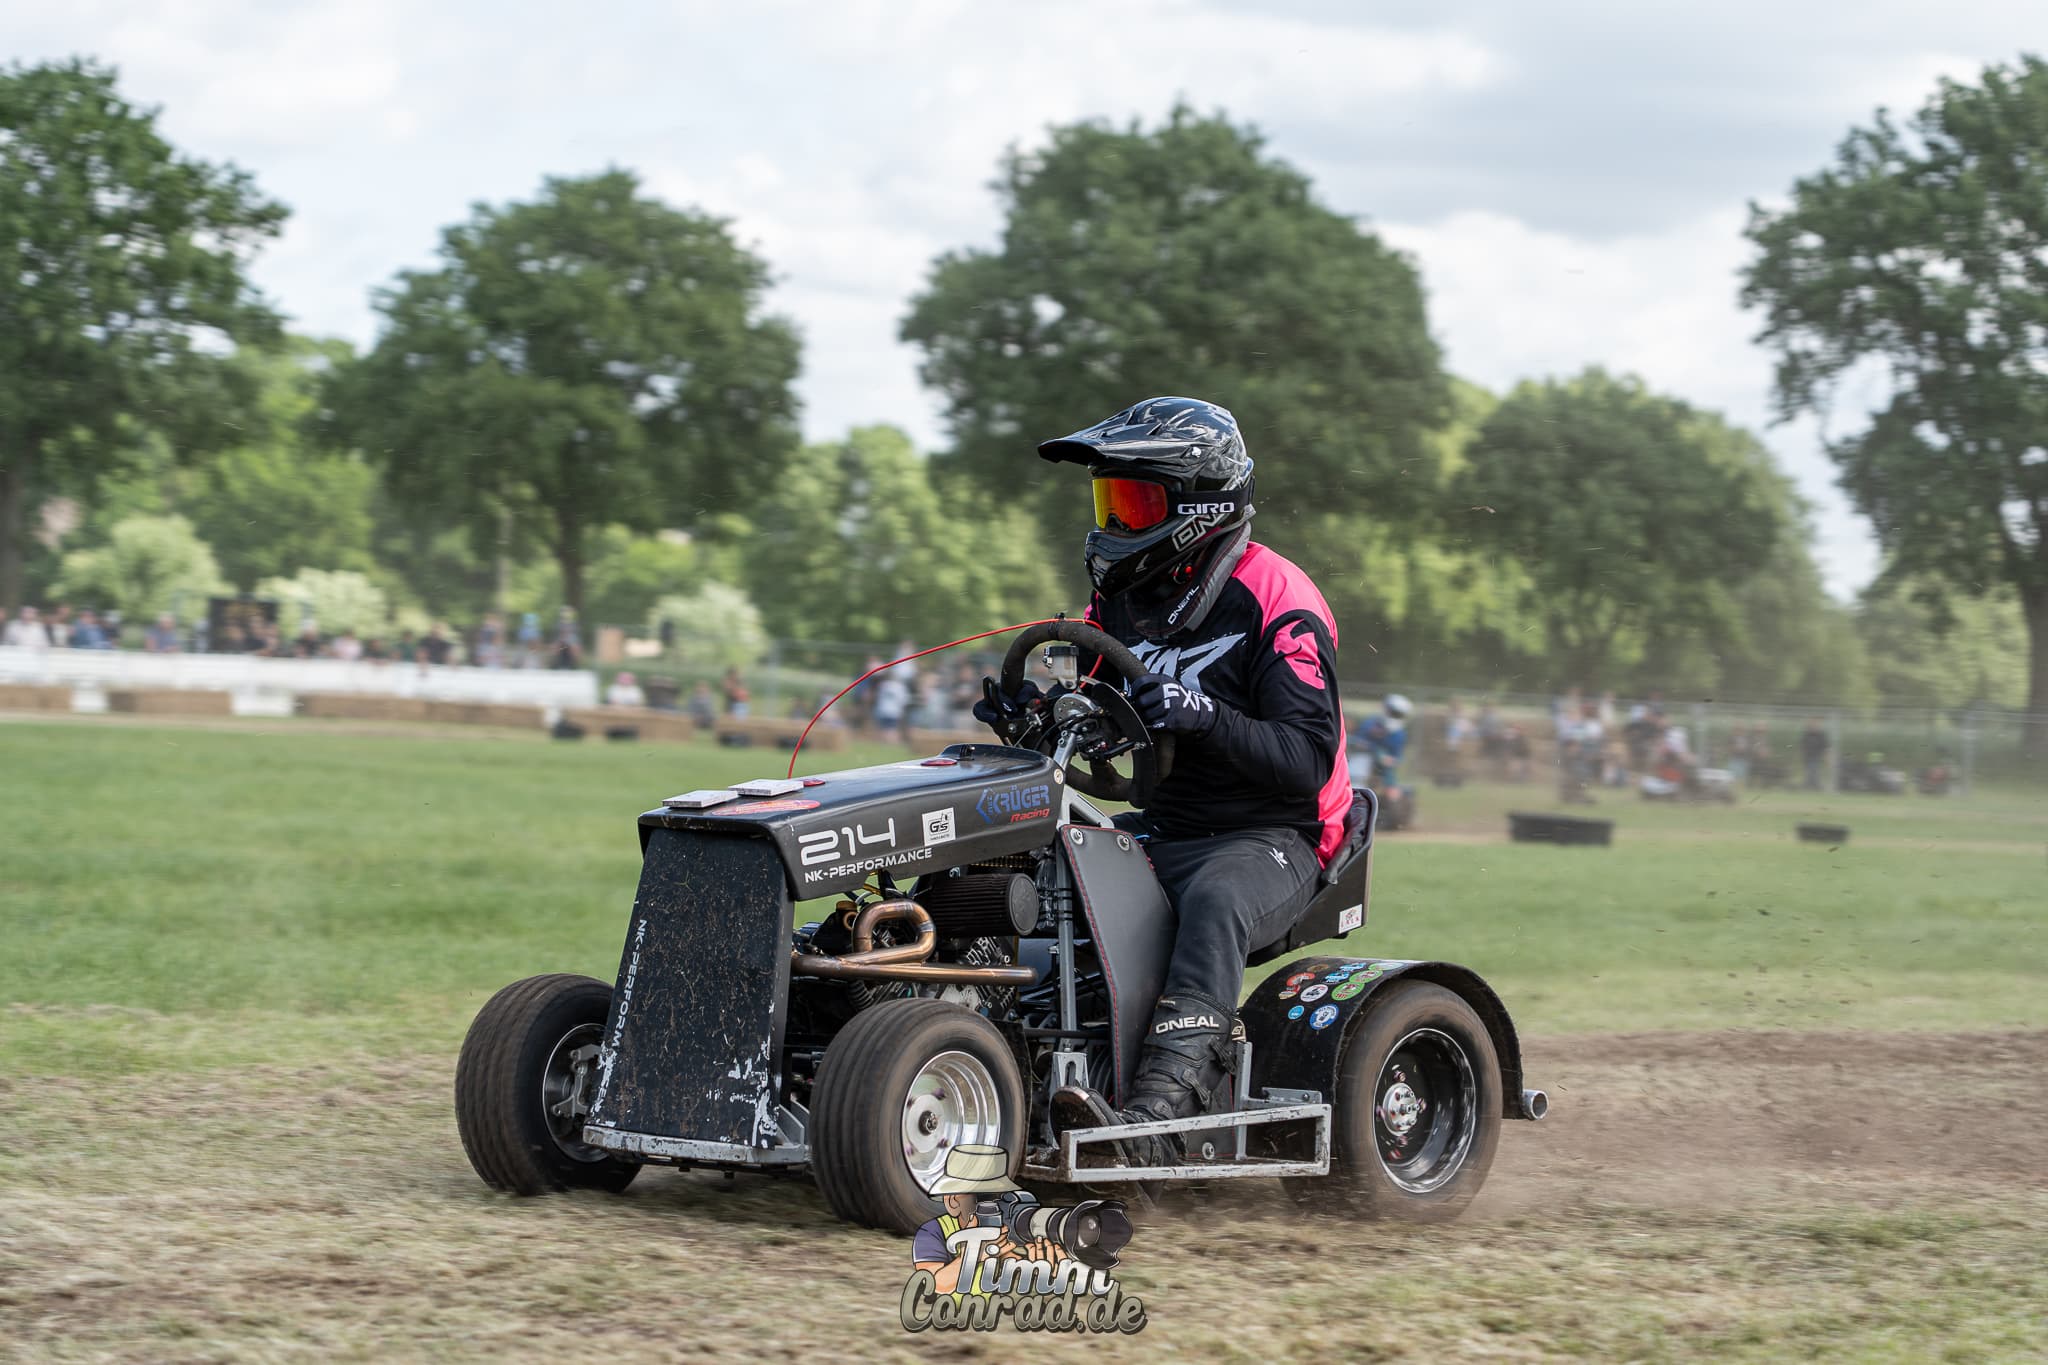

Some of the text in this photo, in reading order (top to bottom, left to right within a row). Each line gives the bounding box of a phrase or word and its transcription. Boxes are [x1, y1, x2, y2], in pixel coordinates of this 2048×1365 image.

[1177, 502, 1235, 515] GIRO
[1162, 683, 1214, 713] FXR
[986, 784, 1050, 815] KRÜGER
[1011, 807, 1050, 823] Racing
[798, 817, 896, 866] 214
[804, 847, 933, 883] NK-PERFORMANCE
[1155, 1015, 1220, 1034] ONEAL
